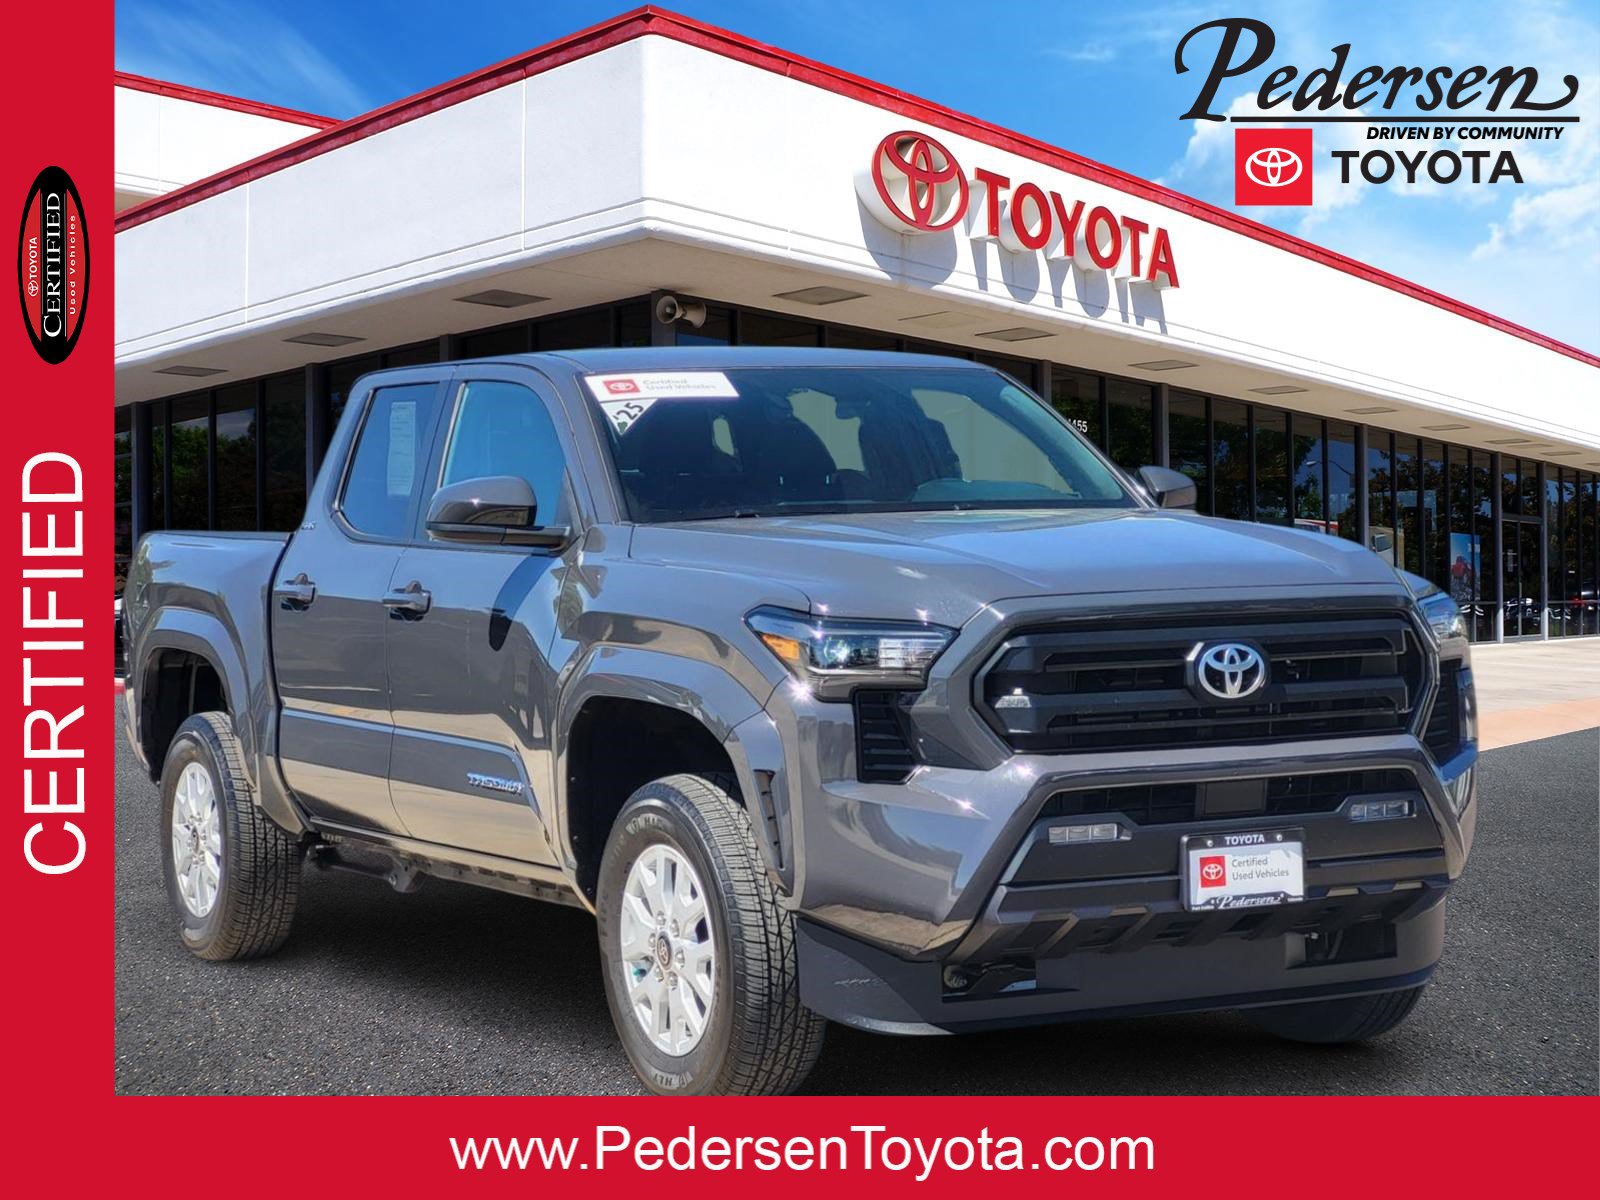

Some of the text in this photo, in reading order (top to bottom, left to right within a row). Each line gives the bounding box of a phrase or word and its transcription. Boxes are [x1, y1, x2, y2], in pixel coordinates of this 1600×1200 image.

[974, 167, 1180, 289] TOYOTA
[1224, 834, 1265, 846] TOYOTA
[1231, 856, 1268, 868] Certified
[1232, 867, 1290, 881] Used Vehicles
[1216, 895, 1281, 910] Pedersen
